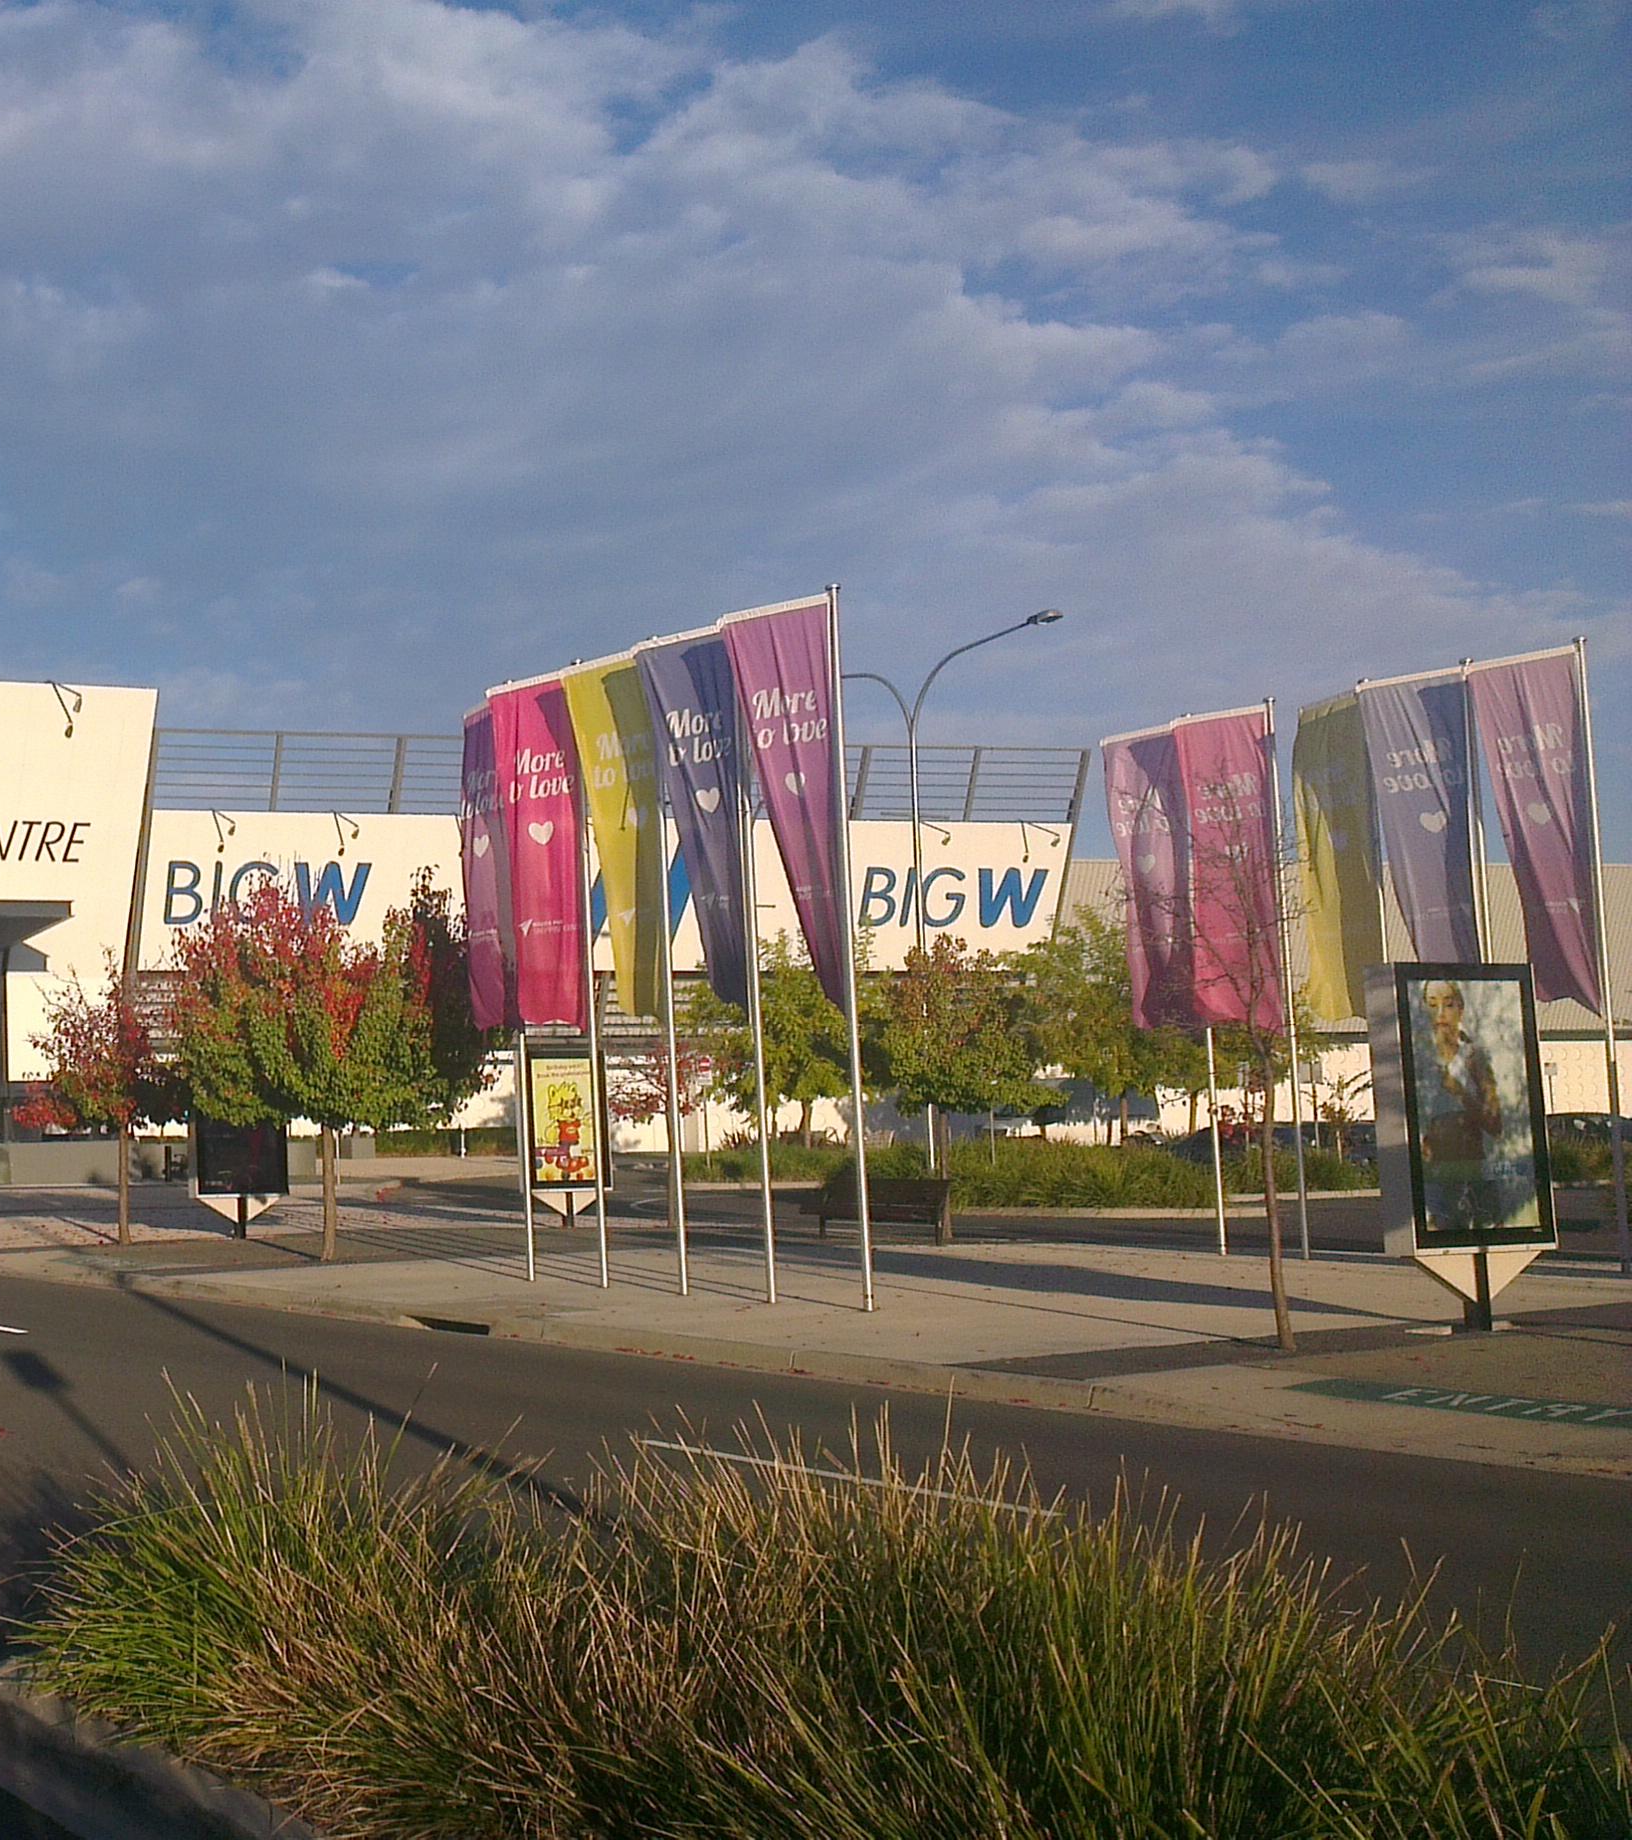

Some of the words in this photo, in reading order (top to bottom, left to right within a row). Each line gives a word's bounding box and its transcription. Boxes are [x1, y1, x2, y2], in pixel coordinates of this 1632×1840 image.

[752, 686, 818, 722] More
[666, 708, 724, 739] More
[514, 748, 566, 776] More
[529, 773, 575, 800] love
